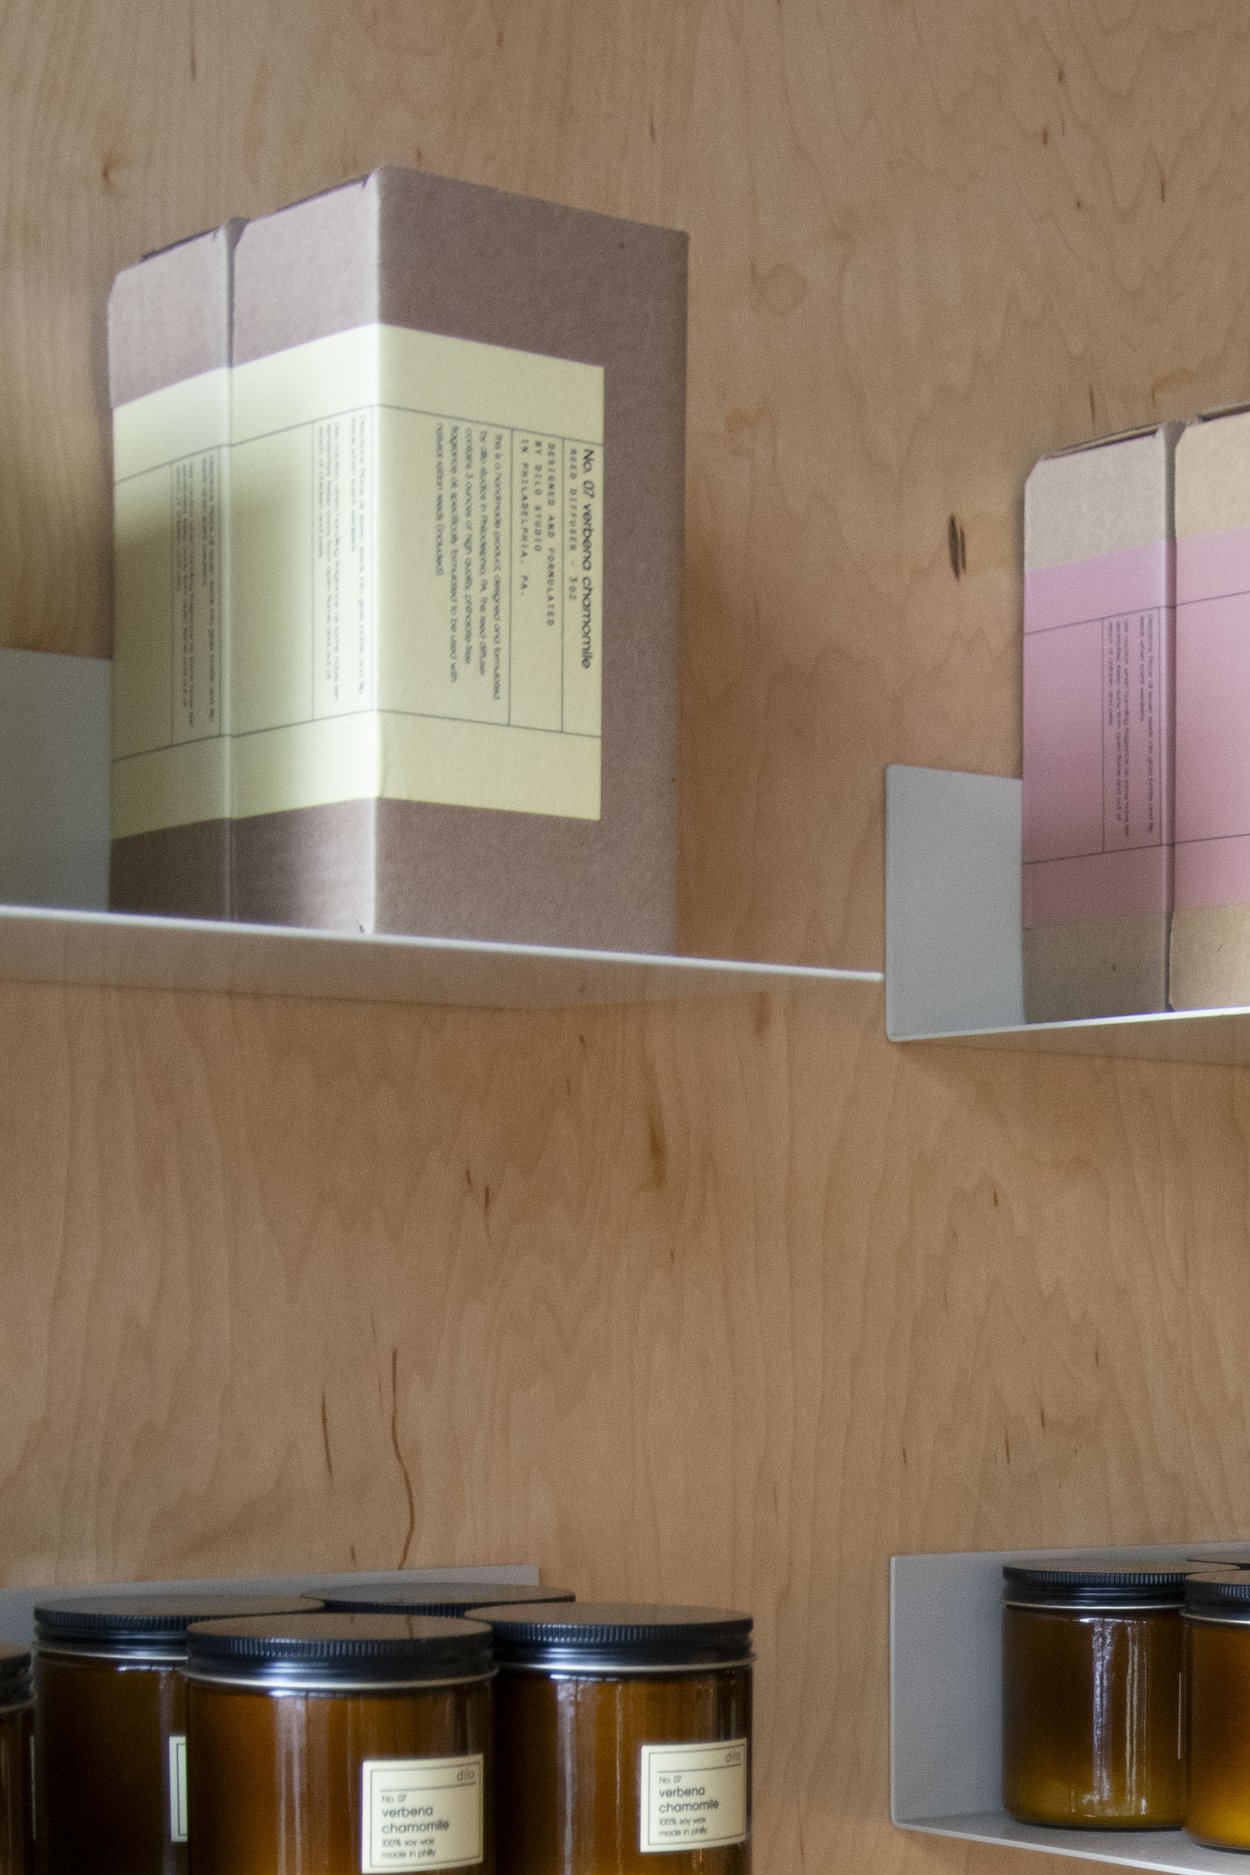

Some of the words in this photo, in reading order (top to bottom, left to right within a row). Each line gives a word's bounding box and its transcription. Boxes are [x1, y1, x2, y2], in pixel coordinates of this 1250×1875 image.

[520, 439, 529, 453] IN
[534, 441, 542, 456] BY
[569, 448, 578, 480] REED
[582, 449, 595, 474] No.
[534, 464, 542, 496] DILO
[547, 443, 555, 506] DESIGNED
[582, 480, 595, 499] 07
[547, 514, 555, 538] AND
[569, 488, 578, 551] DIFFUSER
[534, 504, 542, 553] STUDIO
[582, 504, 595, 571] verbena
[547, 547, 555, 627] FORMULATED
[582, 576, 595, 669] chamomile
[725, 1752, 740, 1763] dilo
[456, 1769, 475, 1781] dilo
[672, 1775, 682, 1783] 07
[397, 1794, 407, 1803] 07
[659, 1786, 706, 1798] verbena
[382, 1806, 434, 1818] verbena
[659, 1799, 719, 1813] chamomile
[381, 1820, 450, 1834] chamomile
[381, 1839, 401, 1847] 100%
[404, 1839, 417, 1847] soy
[381, 1851, 407, 1859] made
[409, 1850, 416, 1858] in
[417, 1848, 437, 1858] philly
